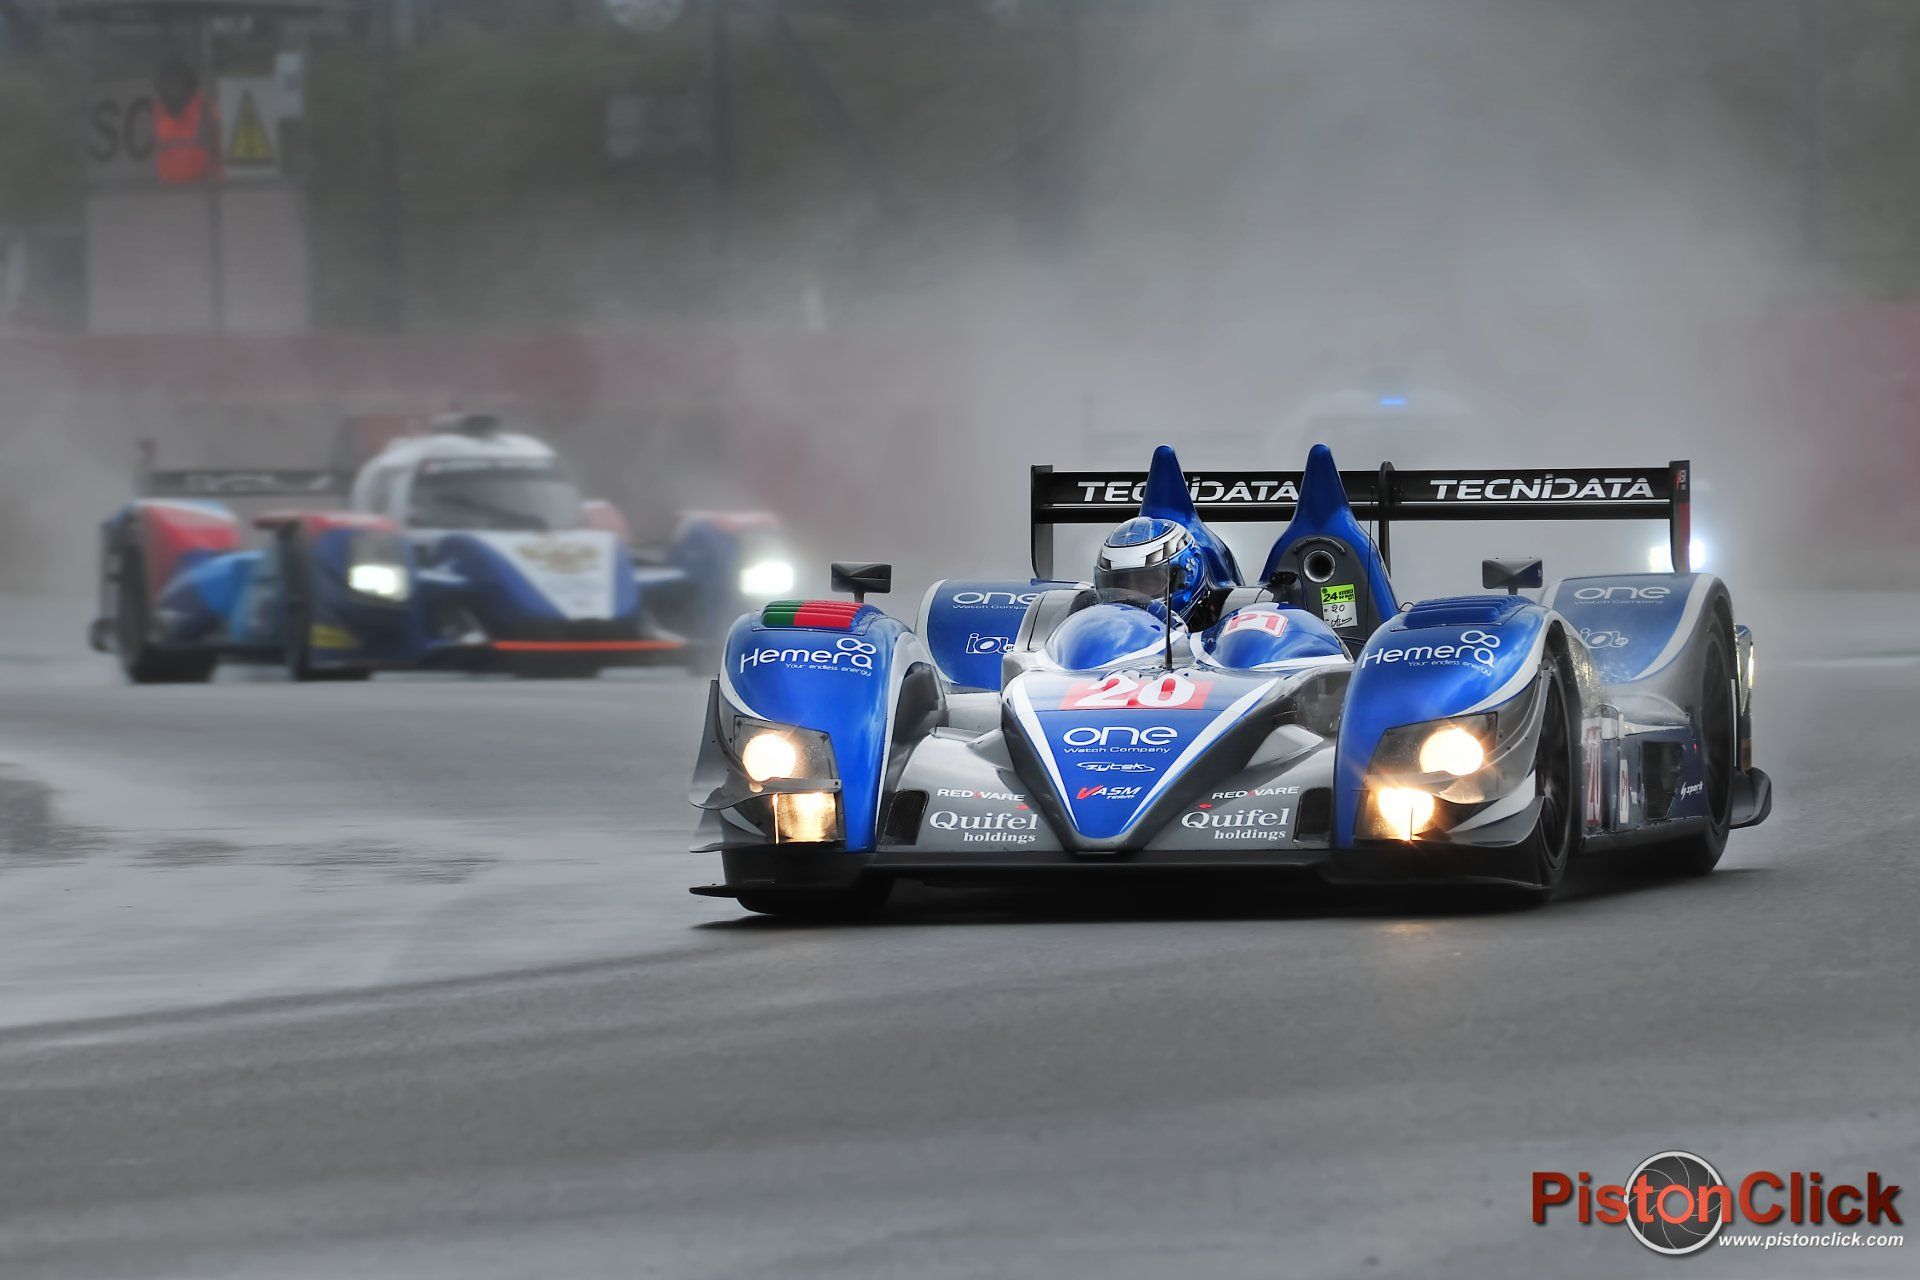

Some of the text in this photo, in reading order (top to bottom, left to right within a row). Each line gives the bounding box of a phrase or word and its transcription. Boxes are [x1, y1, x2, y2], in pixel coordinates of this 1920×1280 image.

[1077, 476, 1299, 502] TECiDATA
[1322, 592, 1338, 602] 24
[1574, 586, 1671, 600] one
[740, 648, 873, 673] Hemera
[1361, 645, 1494, 669] Hemera
[841, 667, 871, 676] energy
[1462, 661, 1492, 677] energy
[1074, 672, 1196, 707] 20
[1063, 727, 1178, 746] one
[929, 811, 1038, 830] Quifel
[1181, 808, 1290, 829] Quifel
[963, 832, 1036, 844] holdings
[1214, 829, 1286, 841] holdings
